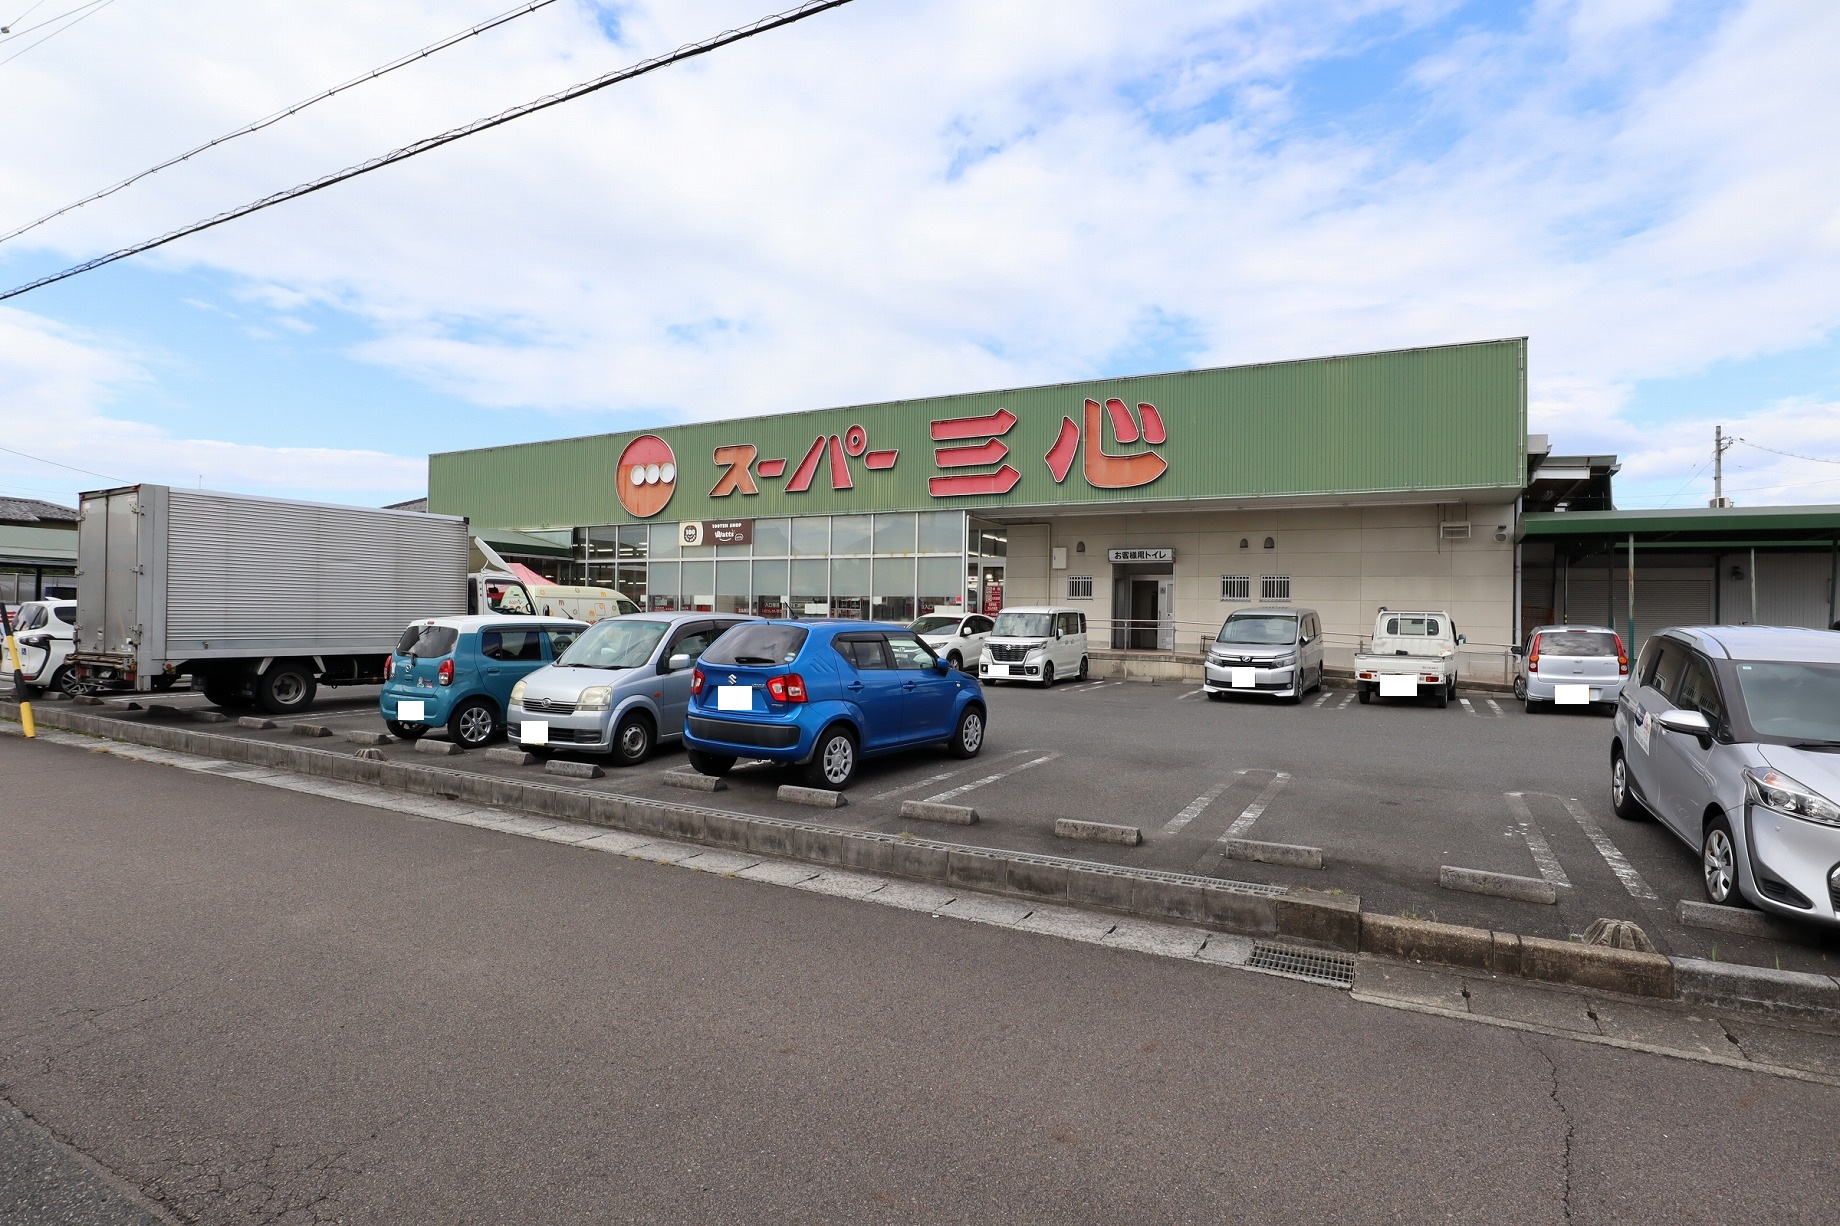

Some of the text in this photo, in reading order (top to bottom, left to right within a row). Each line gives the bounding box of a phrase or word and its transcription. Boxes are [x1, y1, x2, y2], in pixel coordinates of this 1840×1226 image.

[709, 398, 1168, 498] スーパー三心
[714, 530, 734, 538] Watts
[1114, 550, 1167, 559] お客様用トイレ
